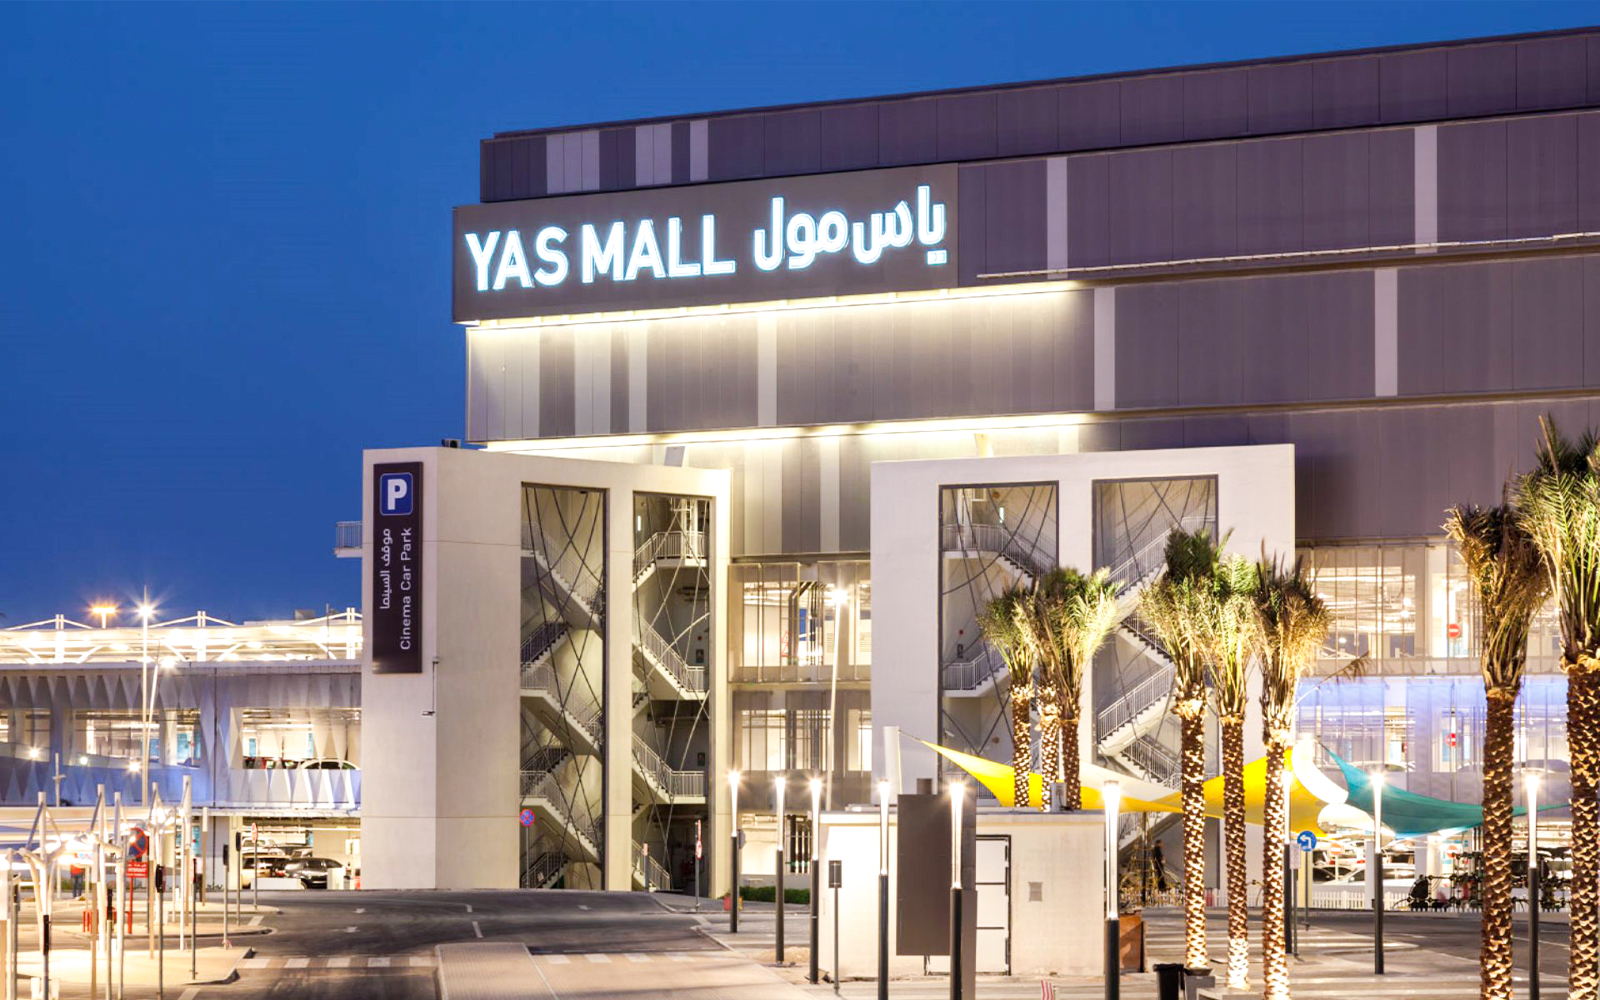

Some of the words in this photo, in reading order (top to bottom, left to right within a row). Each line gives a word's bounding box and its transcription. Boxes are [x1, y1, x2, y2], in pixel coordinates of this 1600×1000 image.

[753, 197, 850, 271] مول
[852, 185, 947, 265] ياس
[464, 227, 570, 292] YAS
[581, 215, 736, 284] MALL
[388, 479, 408, 511] P
[381, 528, 393, 567] موقف
[400, 527, 412, 561] Park
[379, 570, 393, 609] السينما
[400, 565, 412, 591] Car
[400, 596, 412, 650] Cinema
